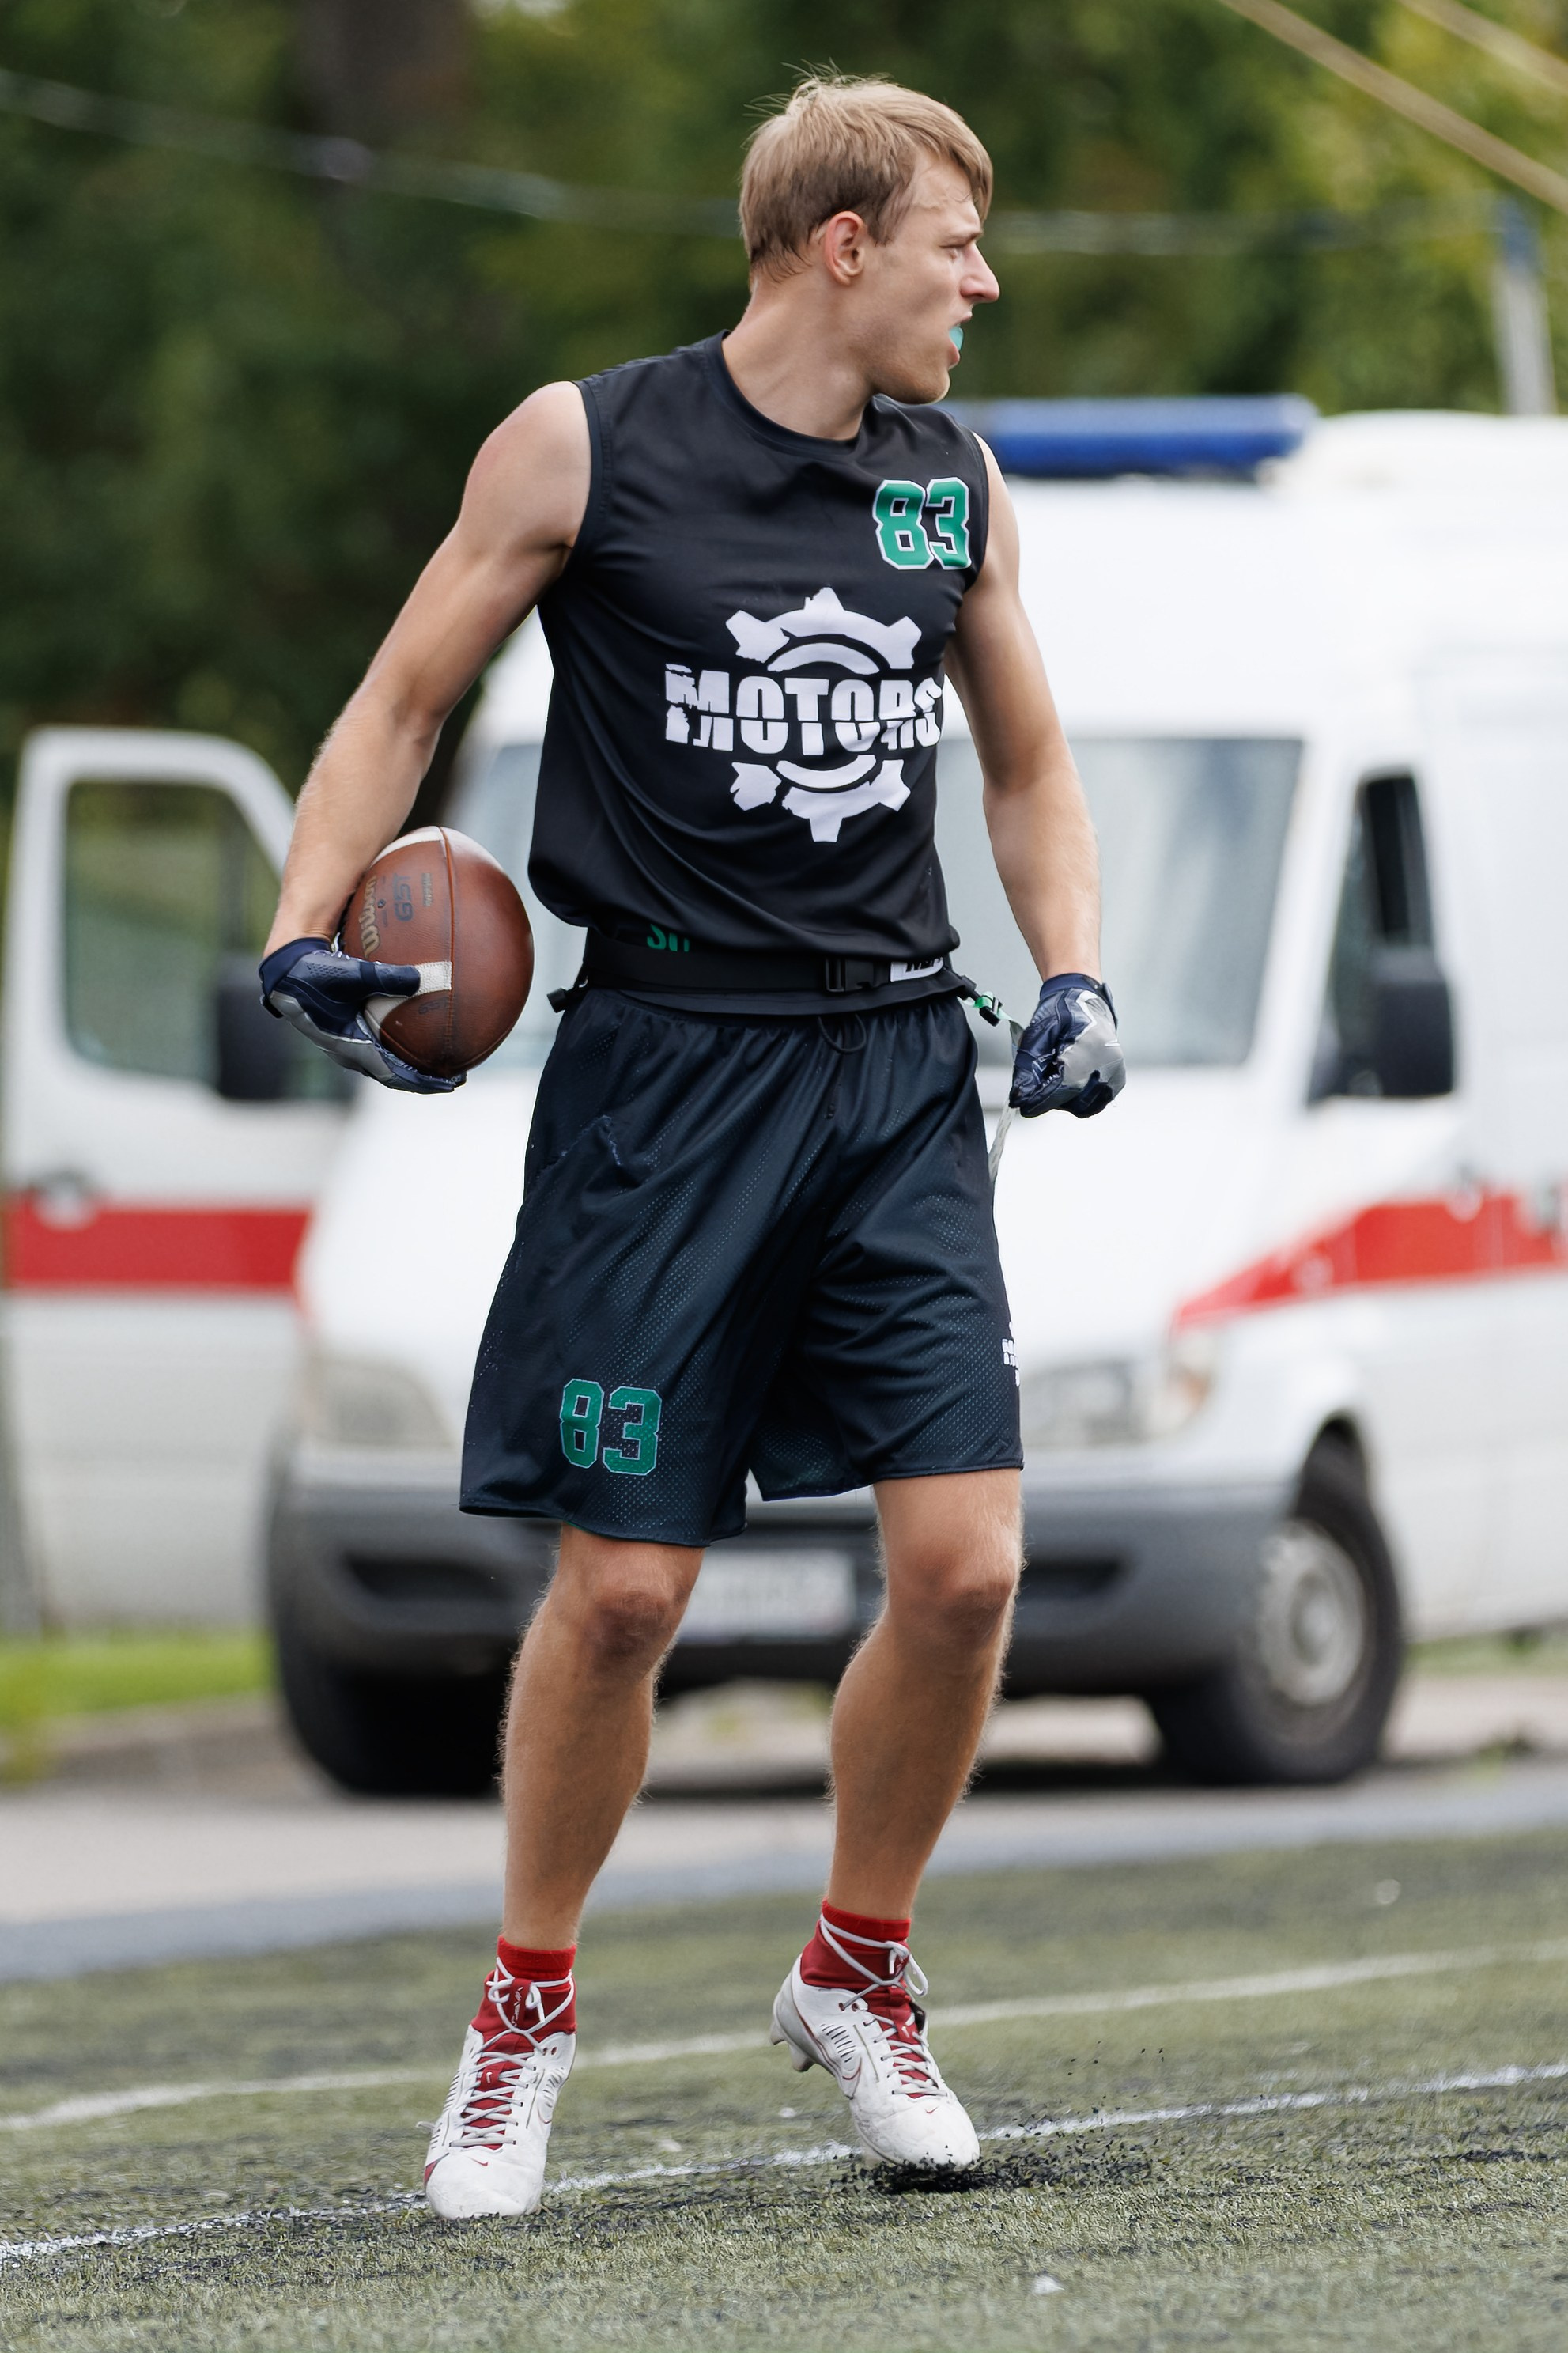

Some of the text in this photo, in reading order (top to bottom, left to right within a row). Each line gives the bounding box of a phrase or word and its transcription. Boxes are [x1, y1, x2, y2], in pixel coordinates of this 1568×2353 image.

[872, 477, 972, 570] 83
[665, 664, 943, 755] MOTORS
[393, 873, 413, 921] GST
[560, 1379, 662, 1475] 83
